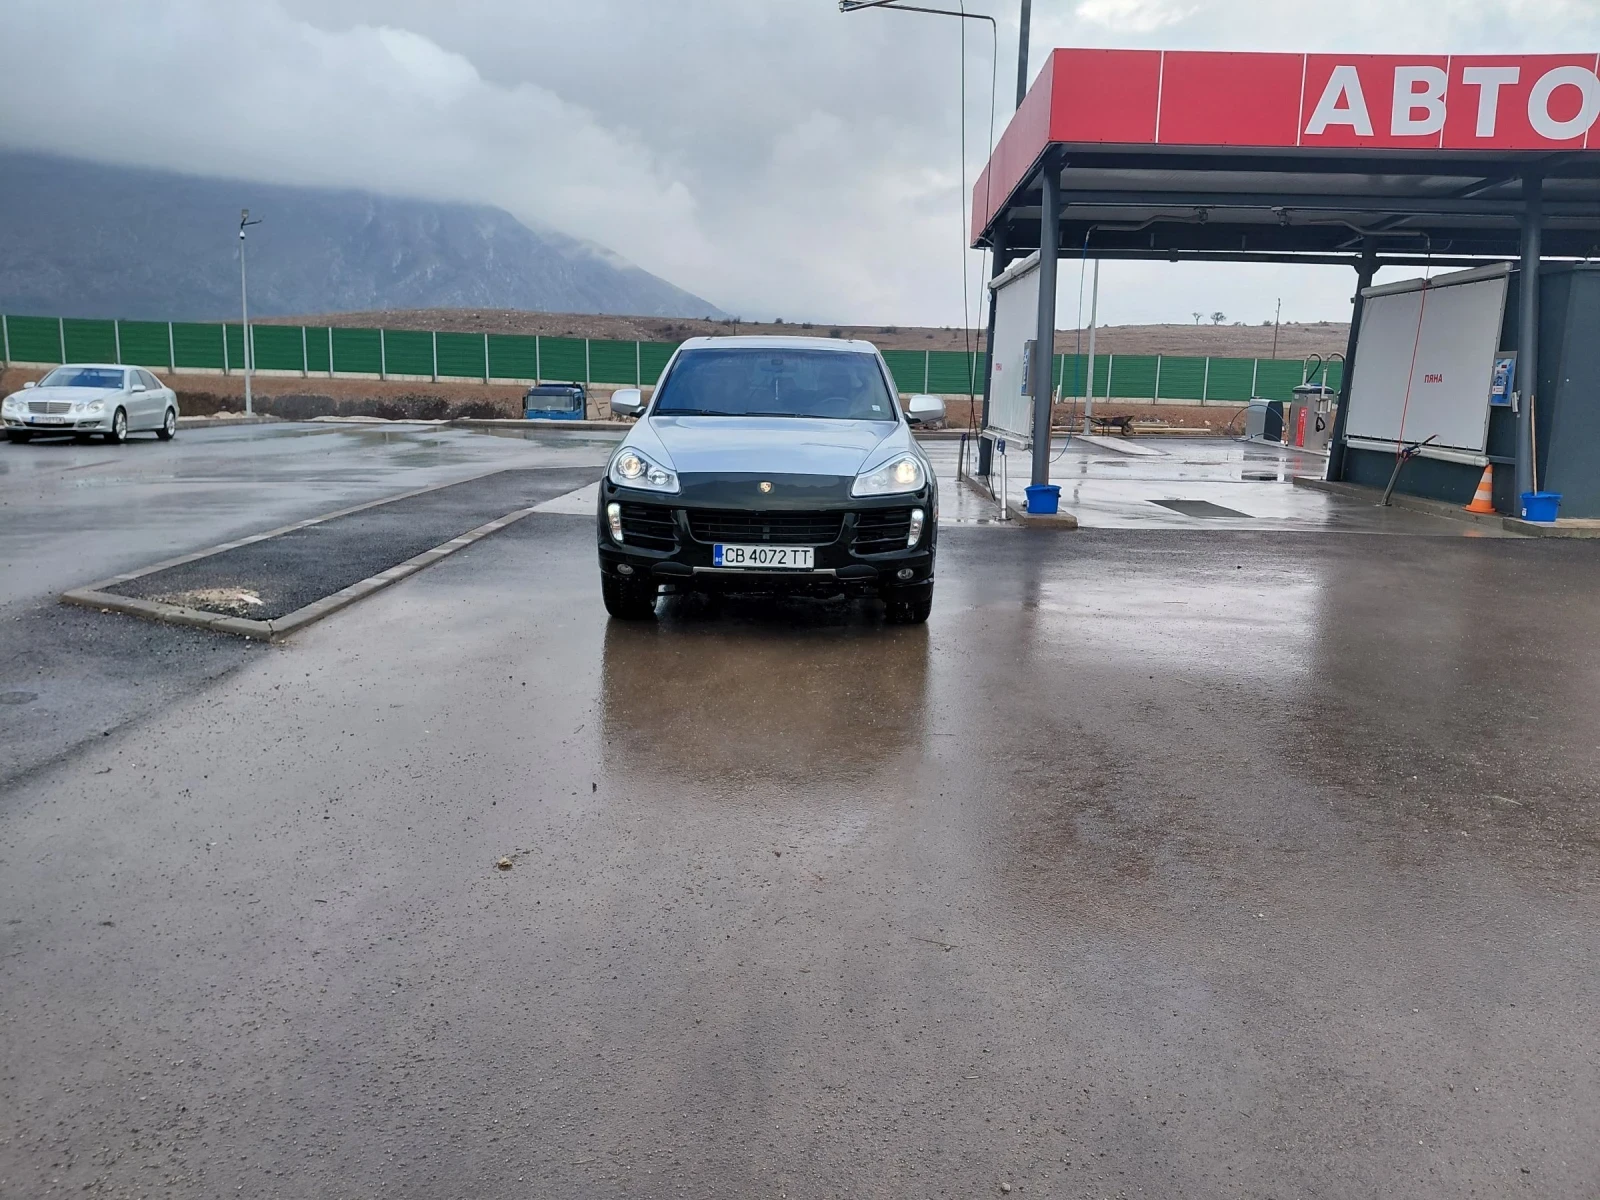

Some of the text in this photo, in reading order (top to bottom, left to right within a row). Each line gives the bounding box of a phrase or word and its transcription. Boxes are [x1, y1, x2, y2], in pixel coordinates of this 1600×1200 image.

[1303, 65, 1600, 140] АВТО
[1424, 373, 1443, 383] ПЯНА
[725, 548, 810, 565] CB 4072 TT
